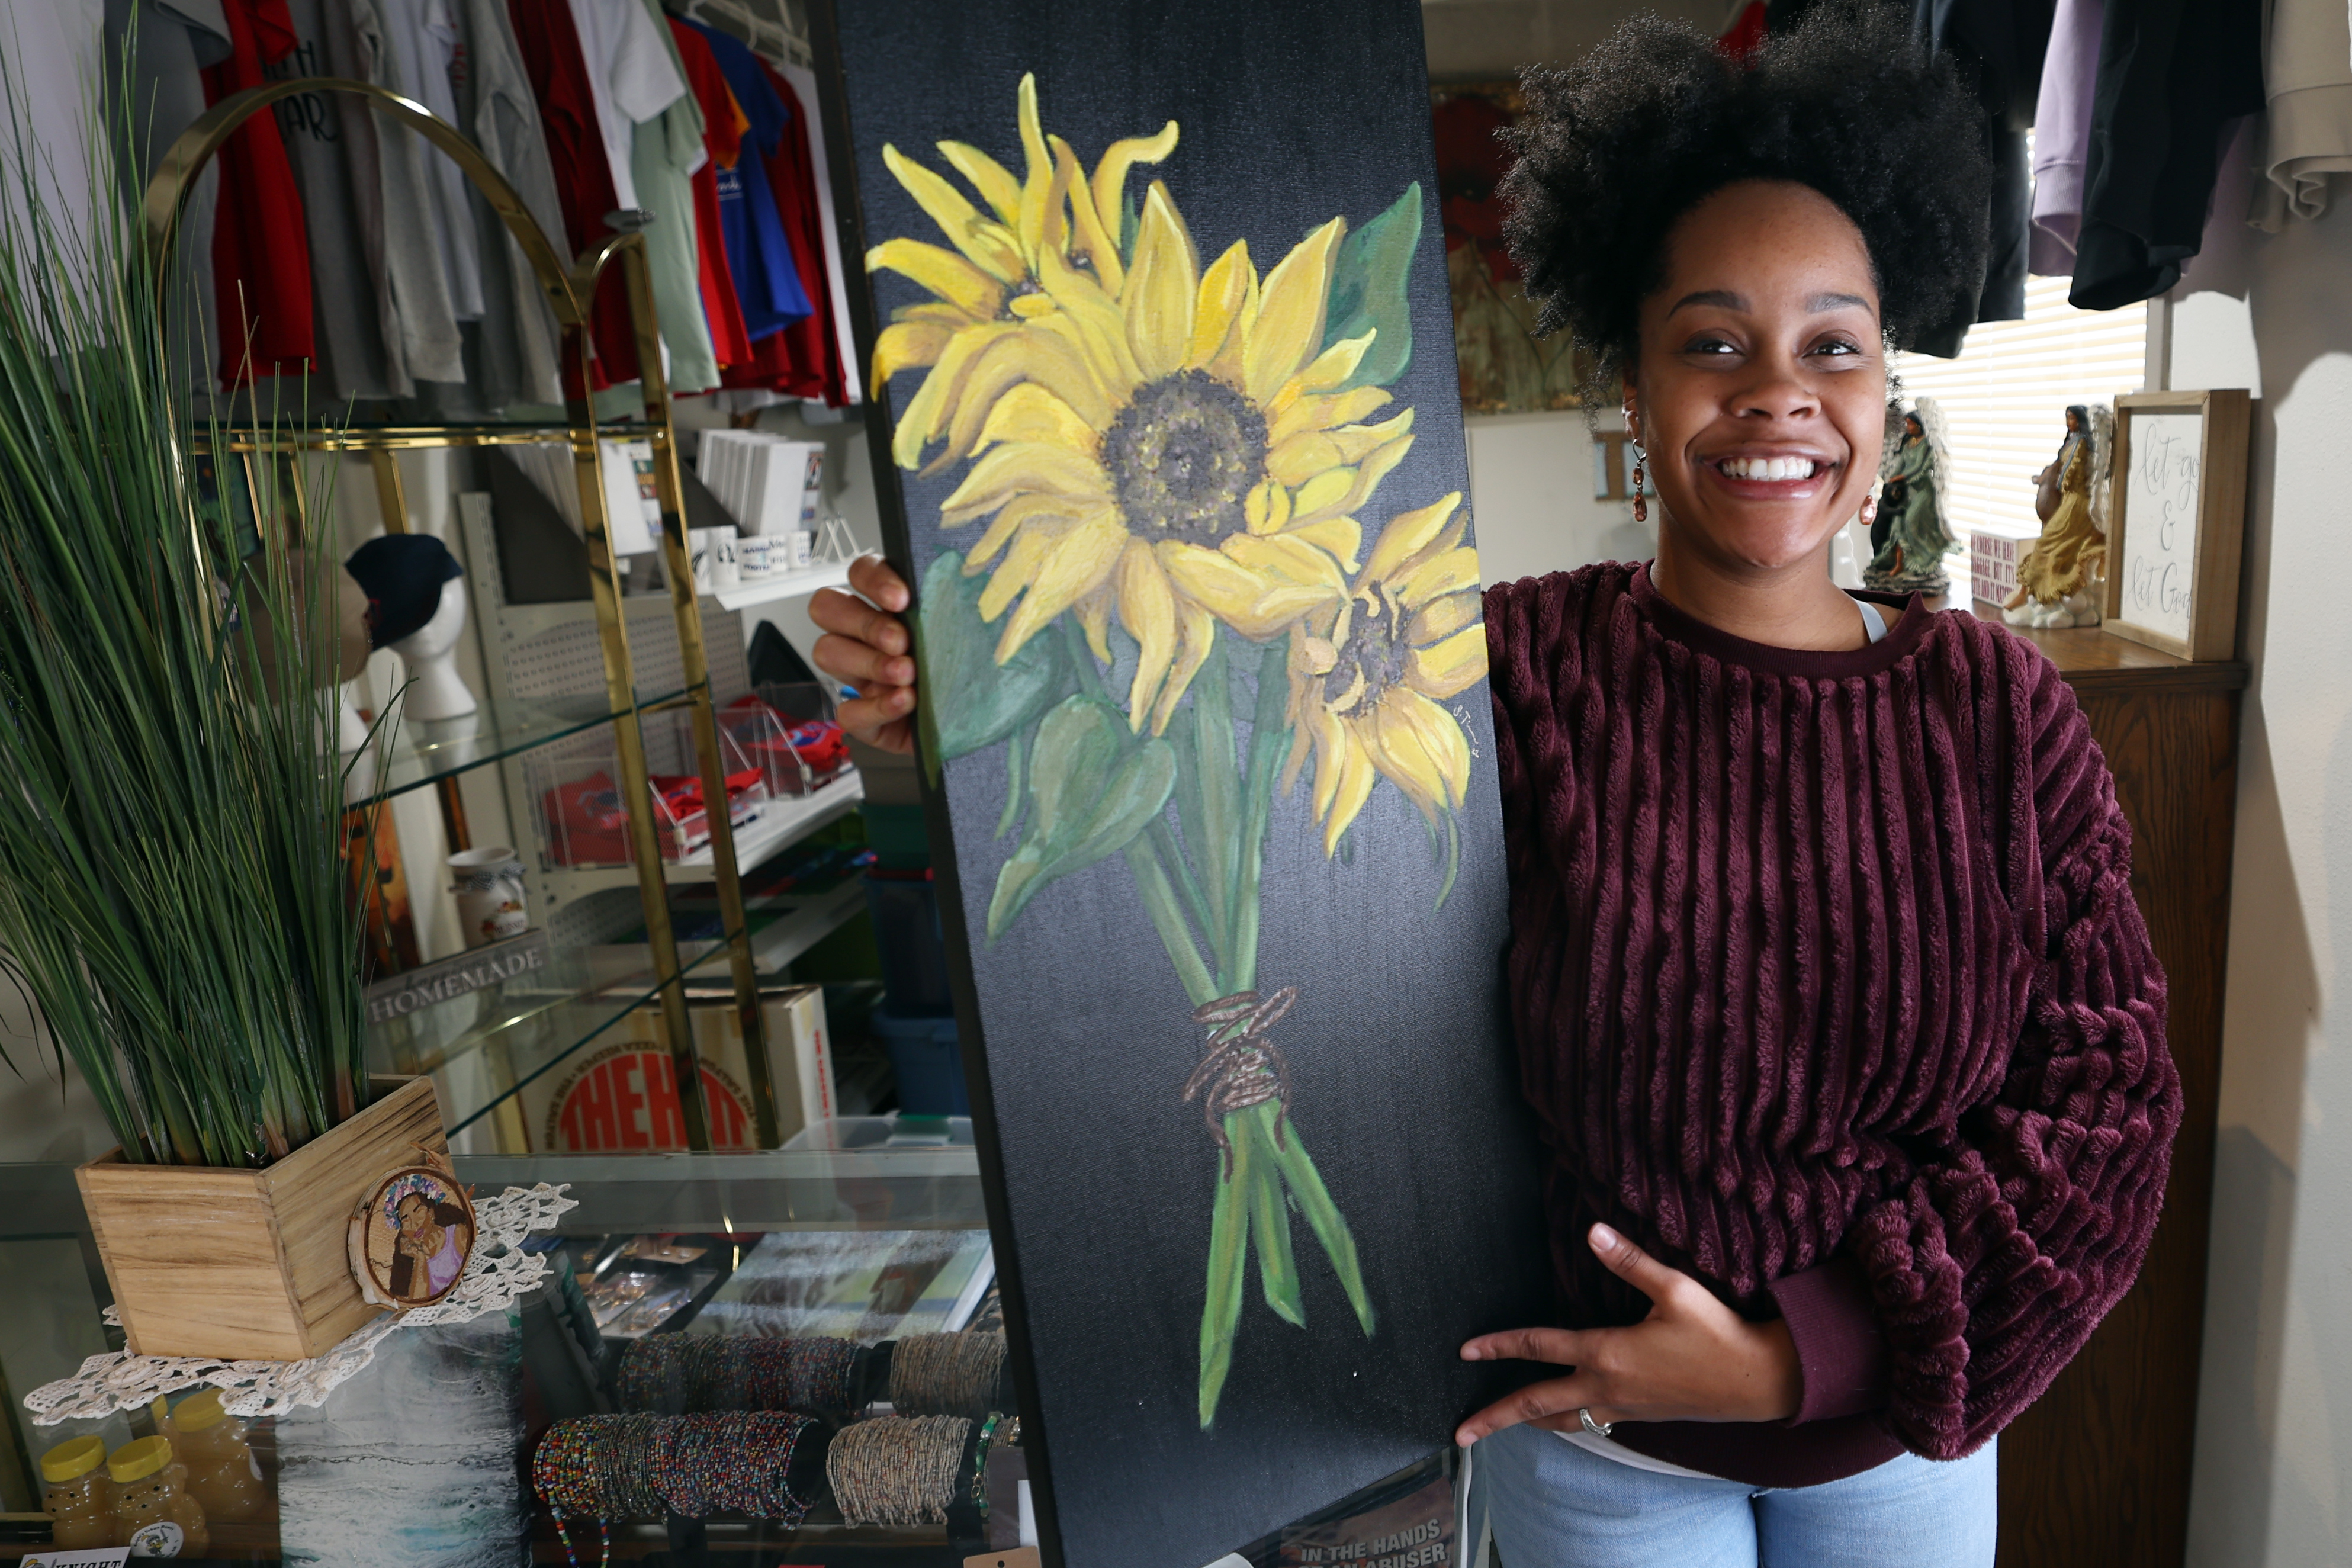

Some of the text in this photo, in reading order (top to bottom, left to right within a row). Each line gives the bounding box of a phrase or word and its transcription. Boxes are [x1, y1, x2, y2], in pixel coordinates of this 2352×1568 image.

[2134, 423, 2200, 510] let go
[2161, 500, 2176, 551] &
[2003, 541, 2014, 563] HAVE
[2126, 555, 2163, 611] let
[369, 948, 543, 1023] HOMEMADE
[1301, 1518, 1441, 1562] IN THE HANDS
[1365, 1542, 1447, 1568] ABUSER
